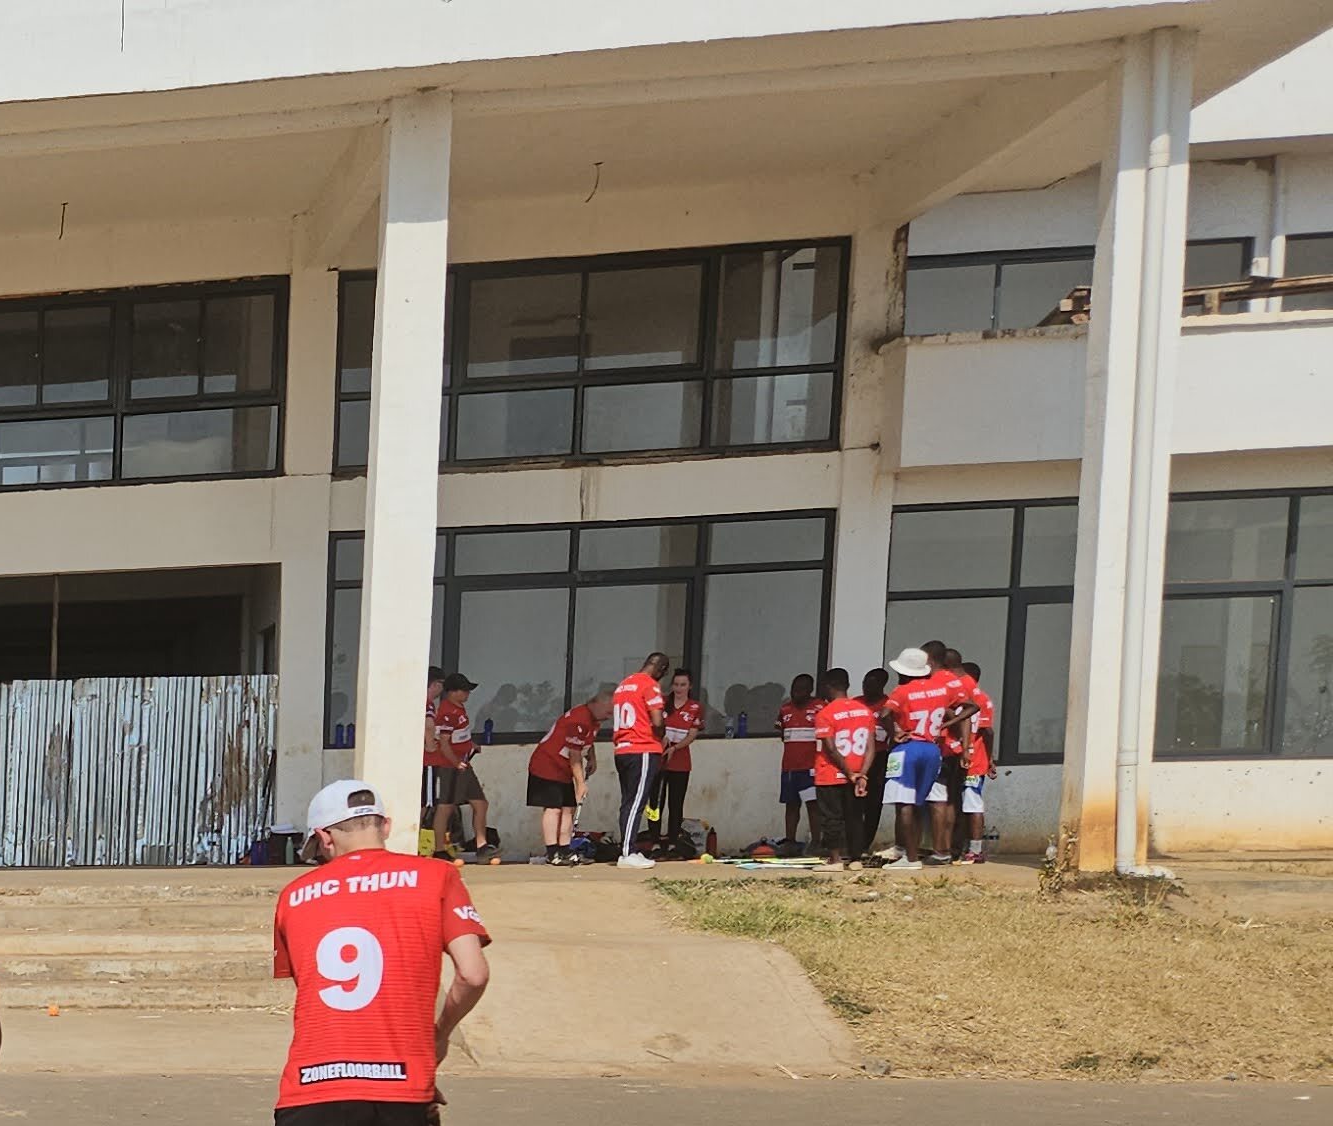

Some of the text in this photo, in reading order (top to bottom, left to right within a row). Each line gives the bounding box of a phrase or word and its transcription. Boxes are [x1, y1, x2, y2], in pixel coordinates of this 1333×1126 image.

[909, 707, 945, 738] 78
[835, 727, 869, 757] 58
[290, 870, 418, 906] UHC THUN
[316, 926, 384, 1011] 9
[301, 1063, 407, 1083] ZONEFLOORBALL
